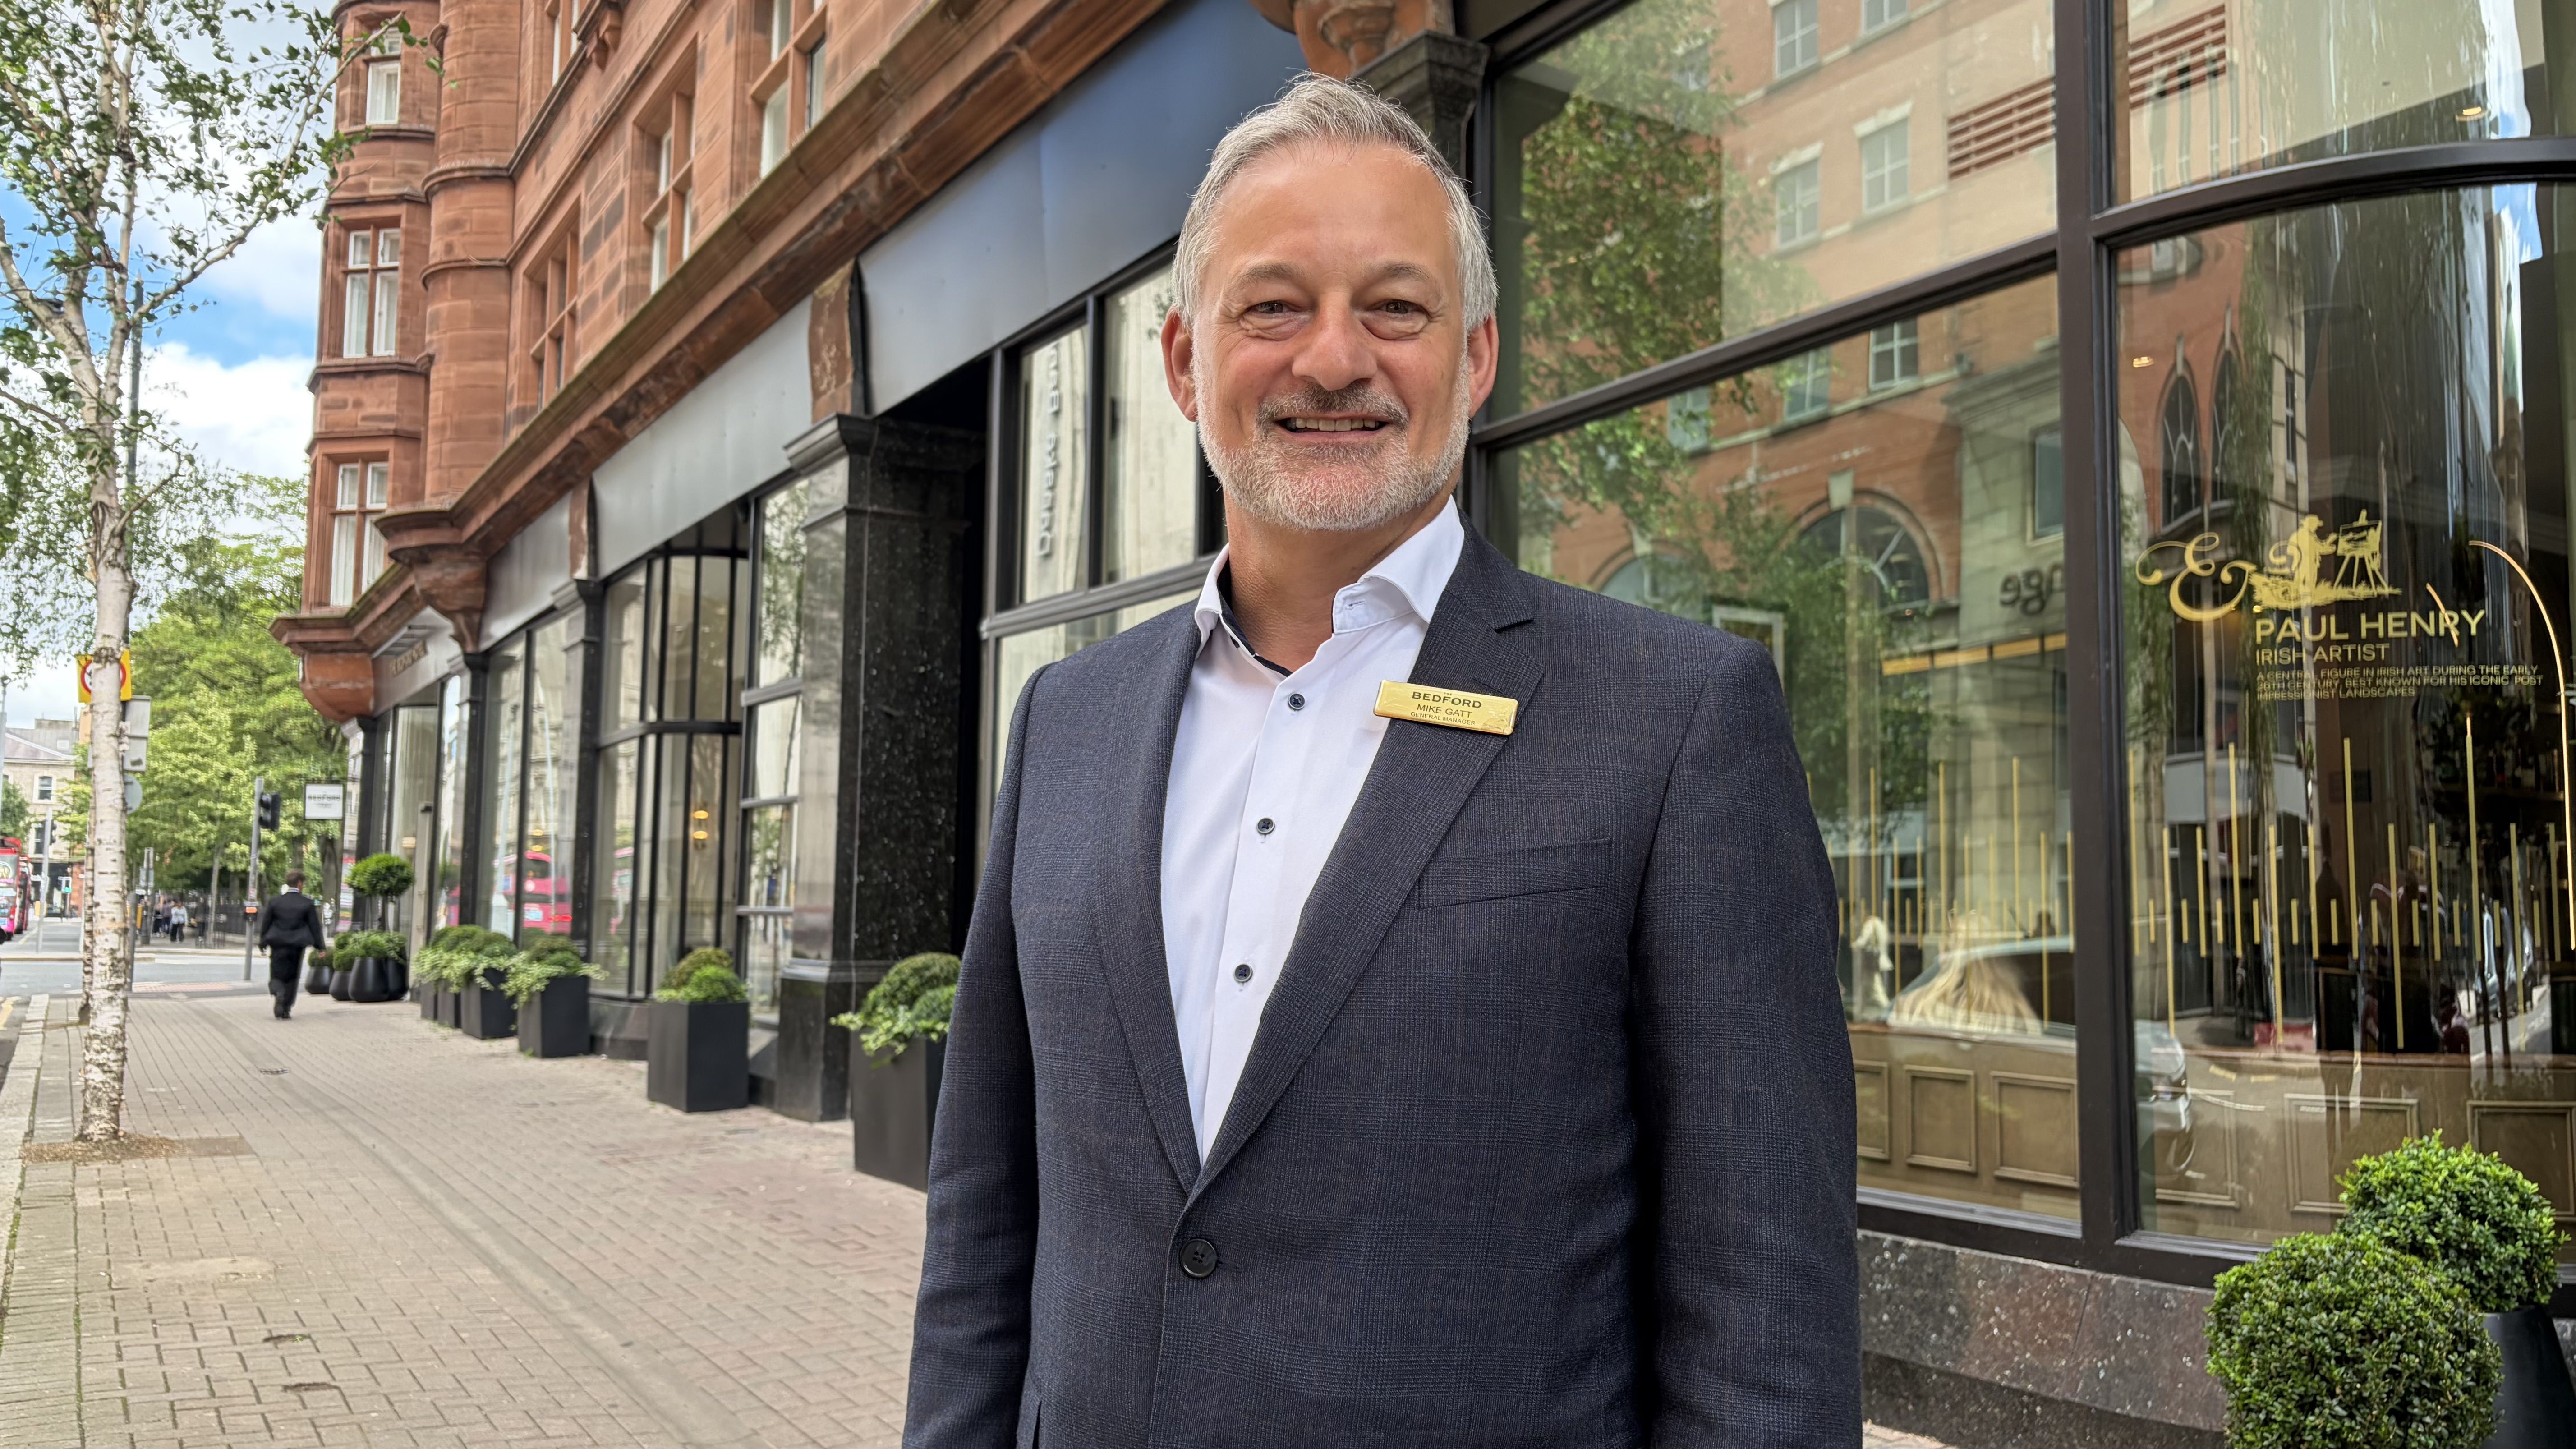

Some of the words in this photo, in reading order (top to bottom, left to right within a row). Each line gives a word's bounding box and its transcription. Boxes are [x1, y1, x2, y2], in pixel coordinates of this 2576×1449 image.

[2256, 615, 2349, 644] PAUL
[2360, 610, 2485, 639] HENRY
[2256, 646, 2305, 666] IRISH
[2313, 643, 2390, 662] ARTIST
[2257, 672, 2264, 682] A
[2267, 669, 2318, 682] CENTRAL
[2321, 667, 2360, 679] FIGURE
[2363, 667, 2374, 677] IN
[2377, 666, 2404, 677] IRISH
[2407, 665, 2429, 676] ART
[2433, 665, 2476, 676] DURING
[2479, 664, 2500, 675] THE
[2504, 664, 2538, 676] EARLY
[2345, 677, 2373, 688] BEST
[2376, 676, 2420, 687] KNOWN
[2424, 676, 2446, 686] FOR
[2450, 675, 2467, 686] HIS
[2470, 675, 2509, 685] ICONIC
[2515, 674, 2544, 685] POST
[1412, 692, 1481, 708] BEDFORD
[2257, 688, 2337, 701] IMPRESSIONIST
[2339, 686, 2415, 699] LANDSCAPES
[1411, 712, 1441, 721] GENERAL
[1443, 717, 1476, 725] MANAGER
[1417, 704, 1443, 713] MIKE
[1445, 708, 1472, 718] GATT
